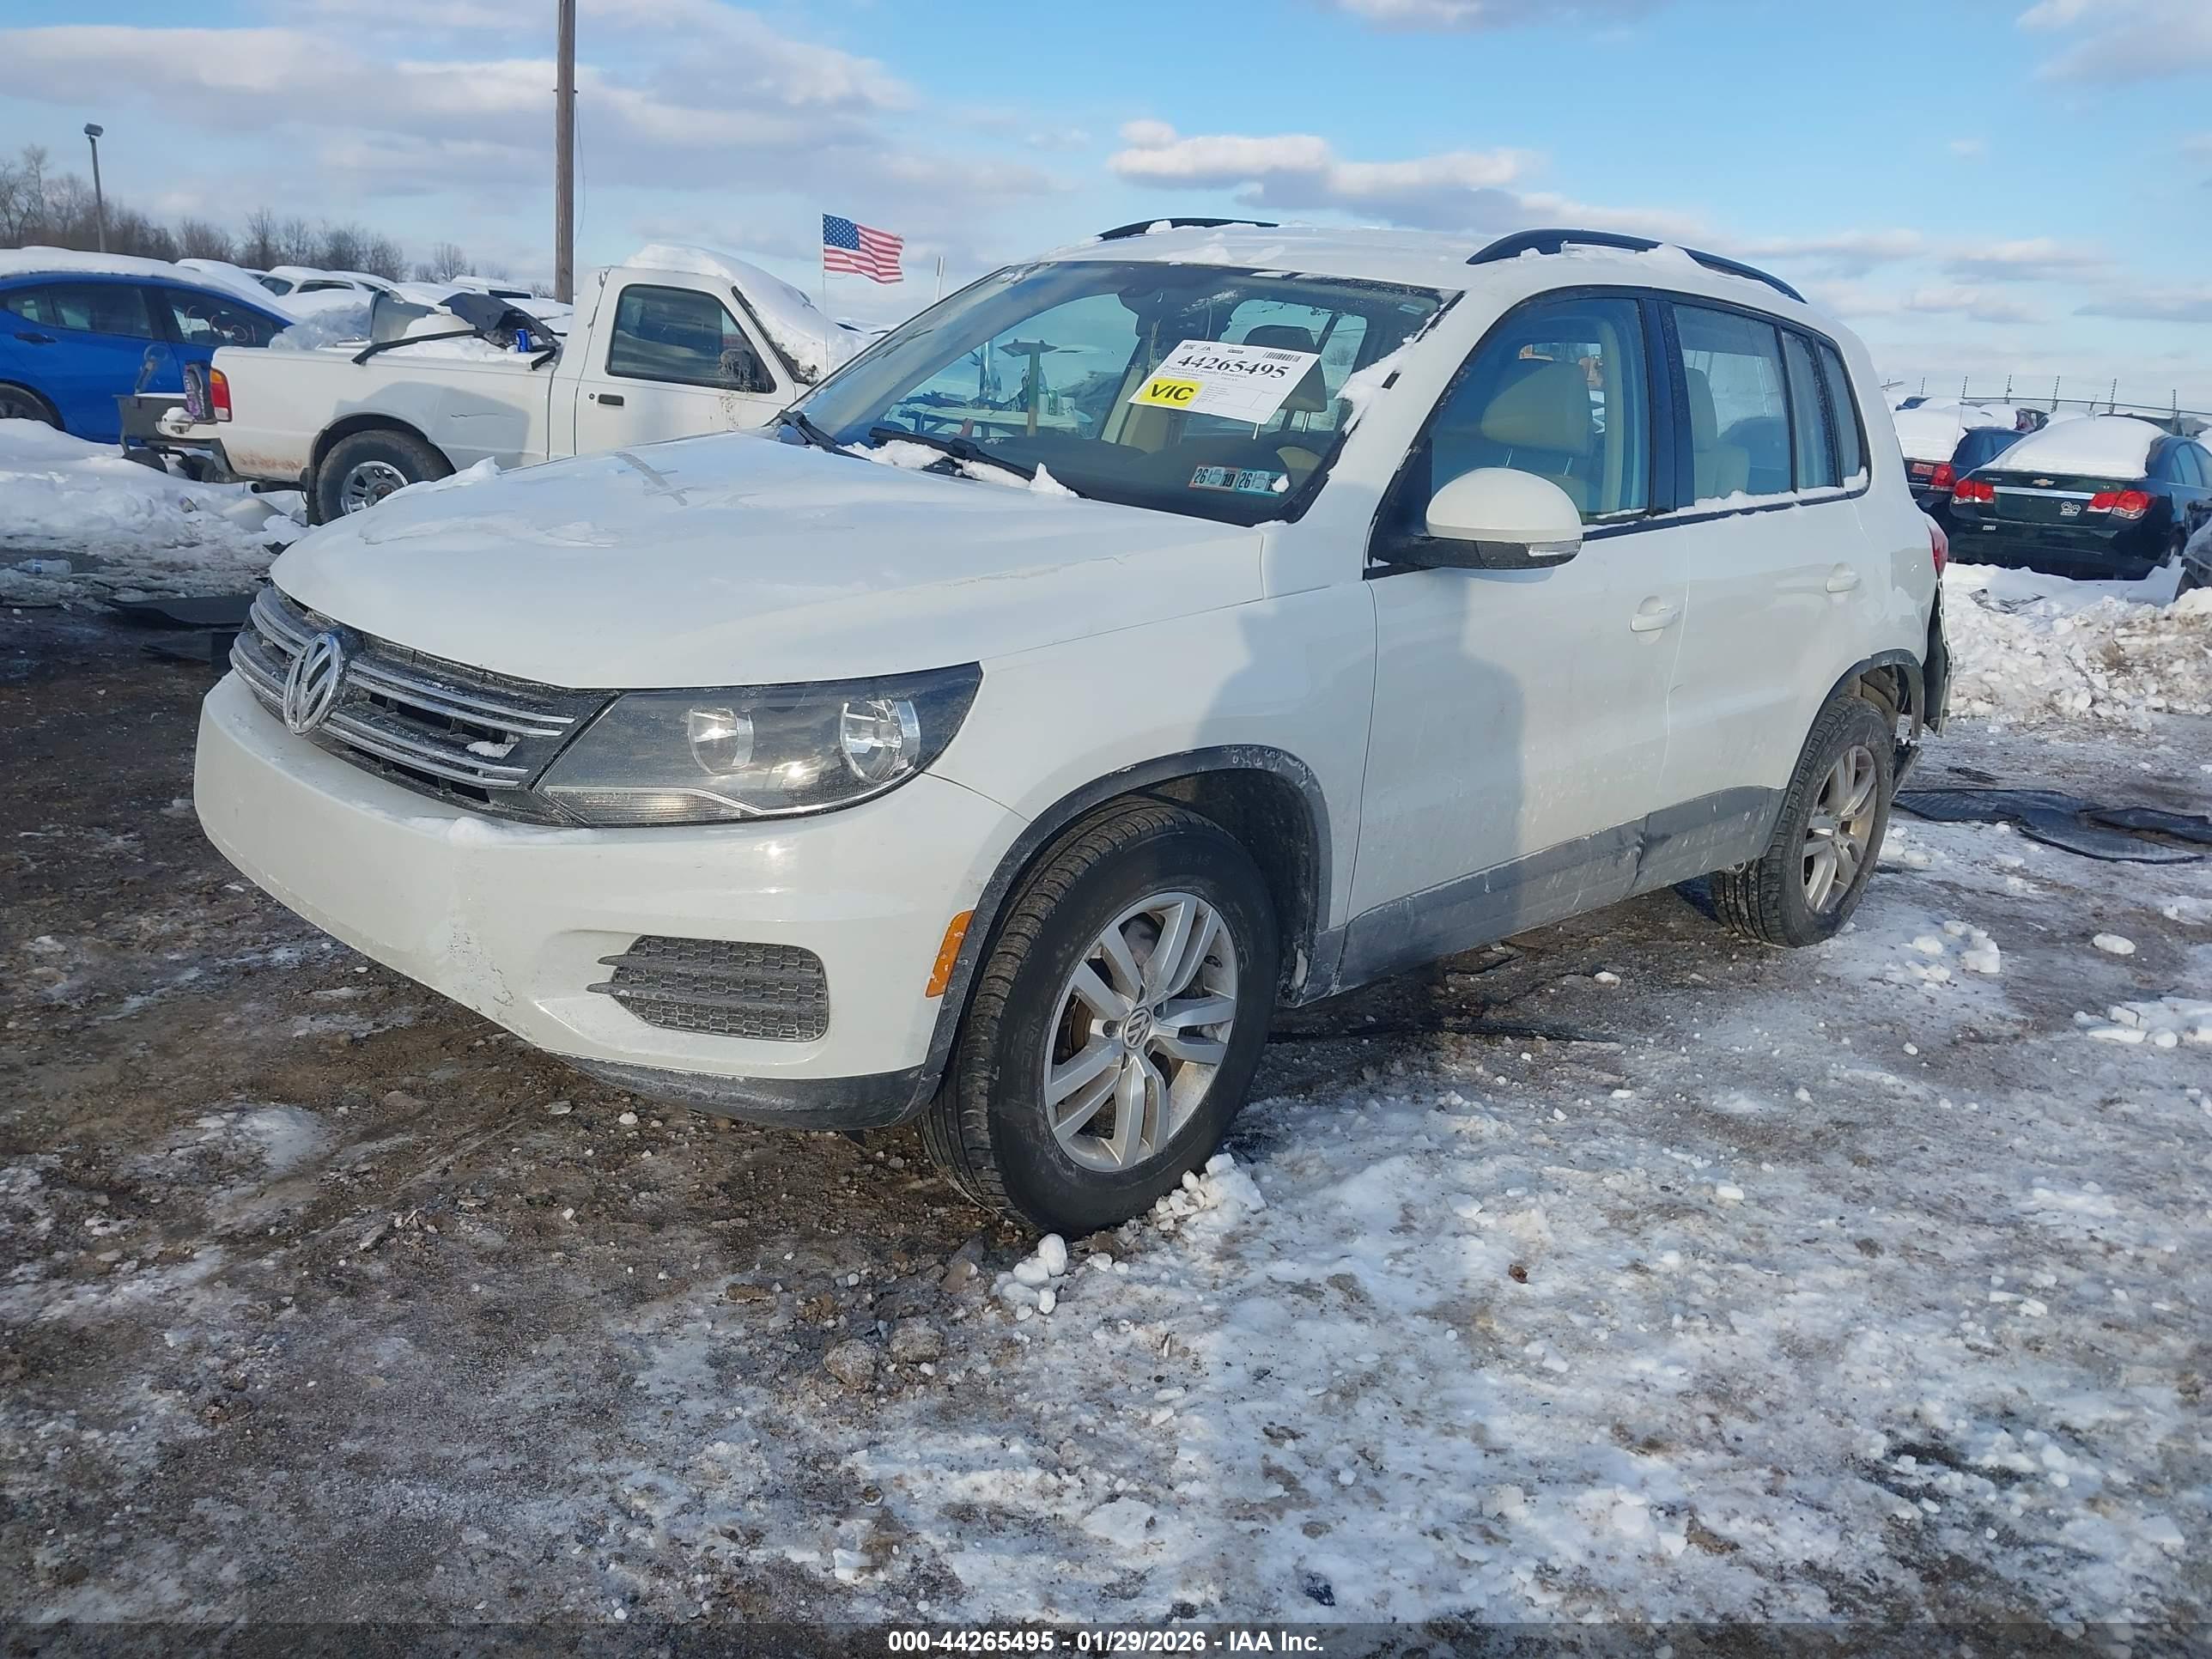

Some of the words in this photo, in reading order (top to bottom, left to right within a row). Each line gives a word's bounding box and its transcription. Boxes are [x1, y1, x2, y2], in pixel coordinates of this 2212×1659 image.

[1177, 355, 1291, 379] 44265495
[1151, 384, 1194, 400] VIC
[1194, 468, 1208, 483] 26
[1238, 472, 1252, 488] 26
